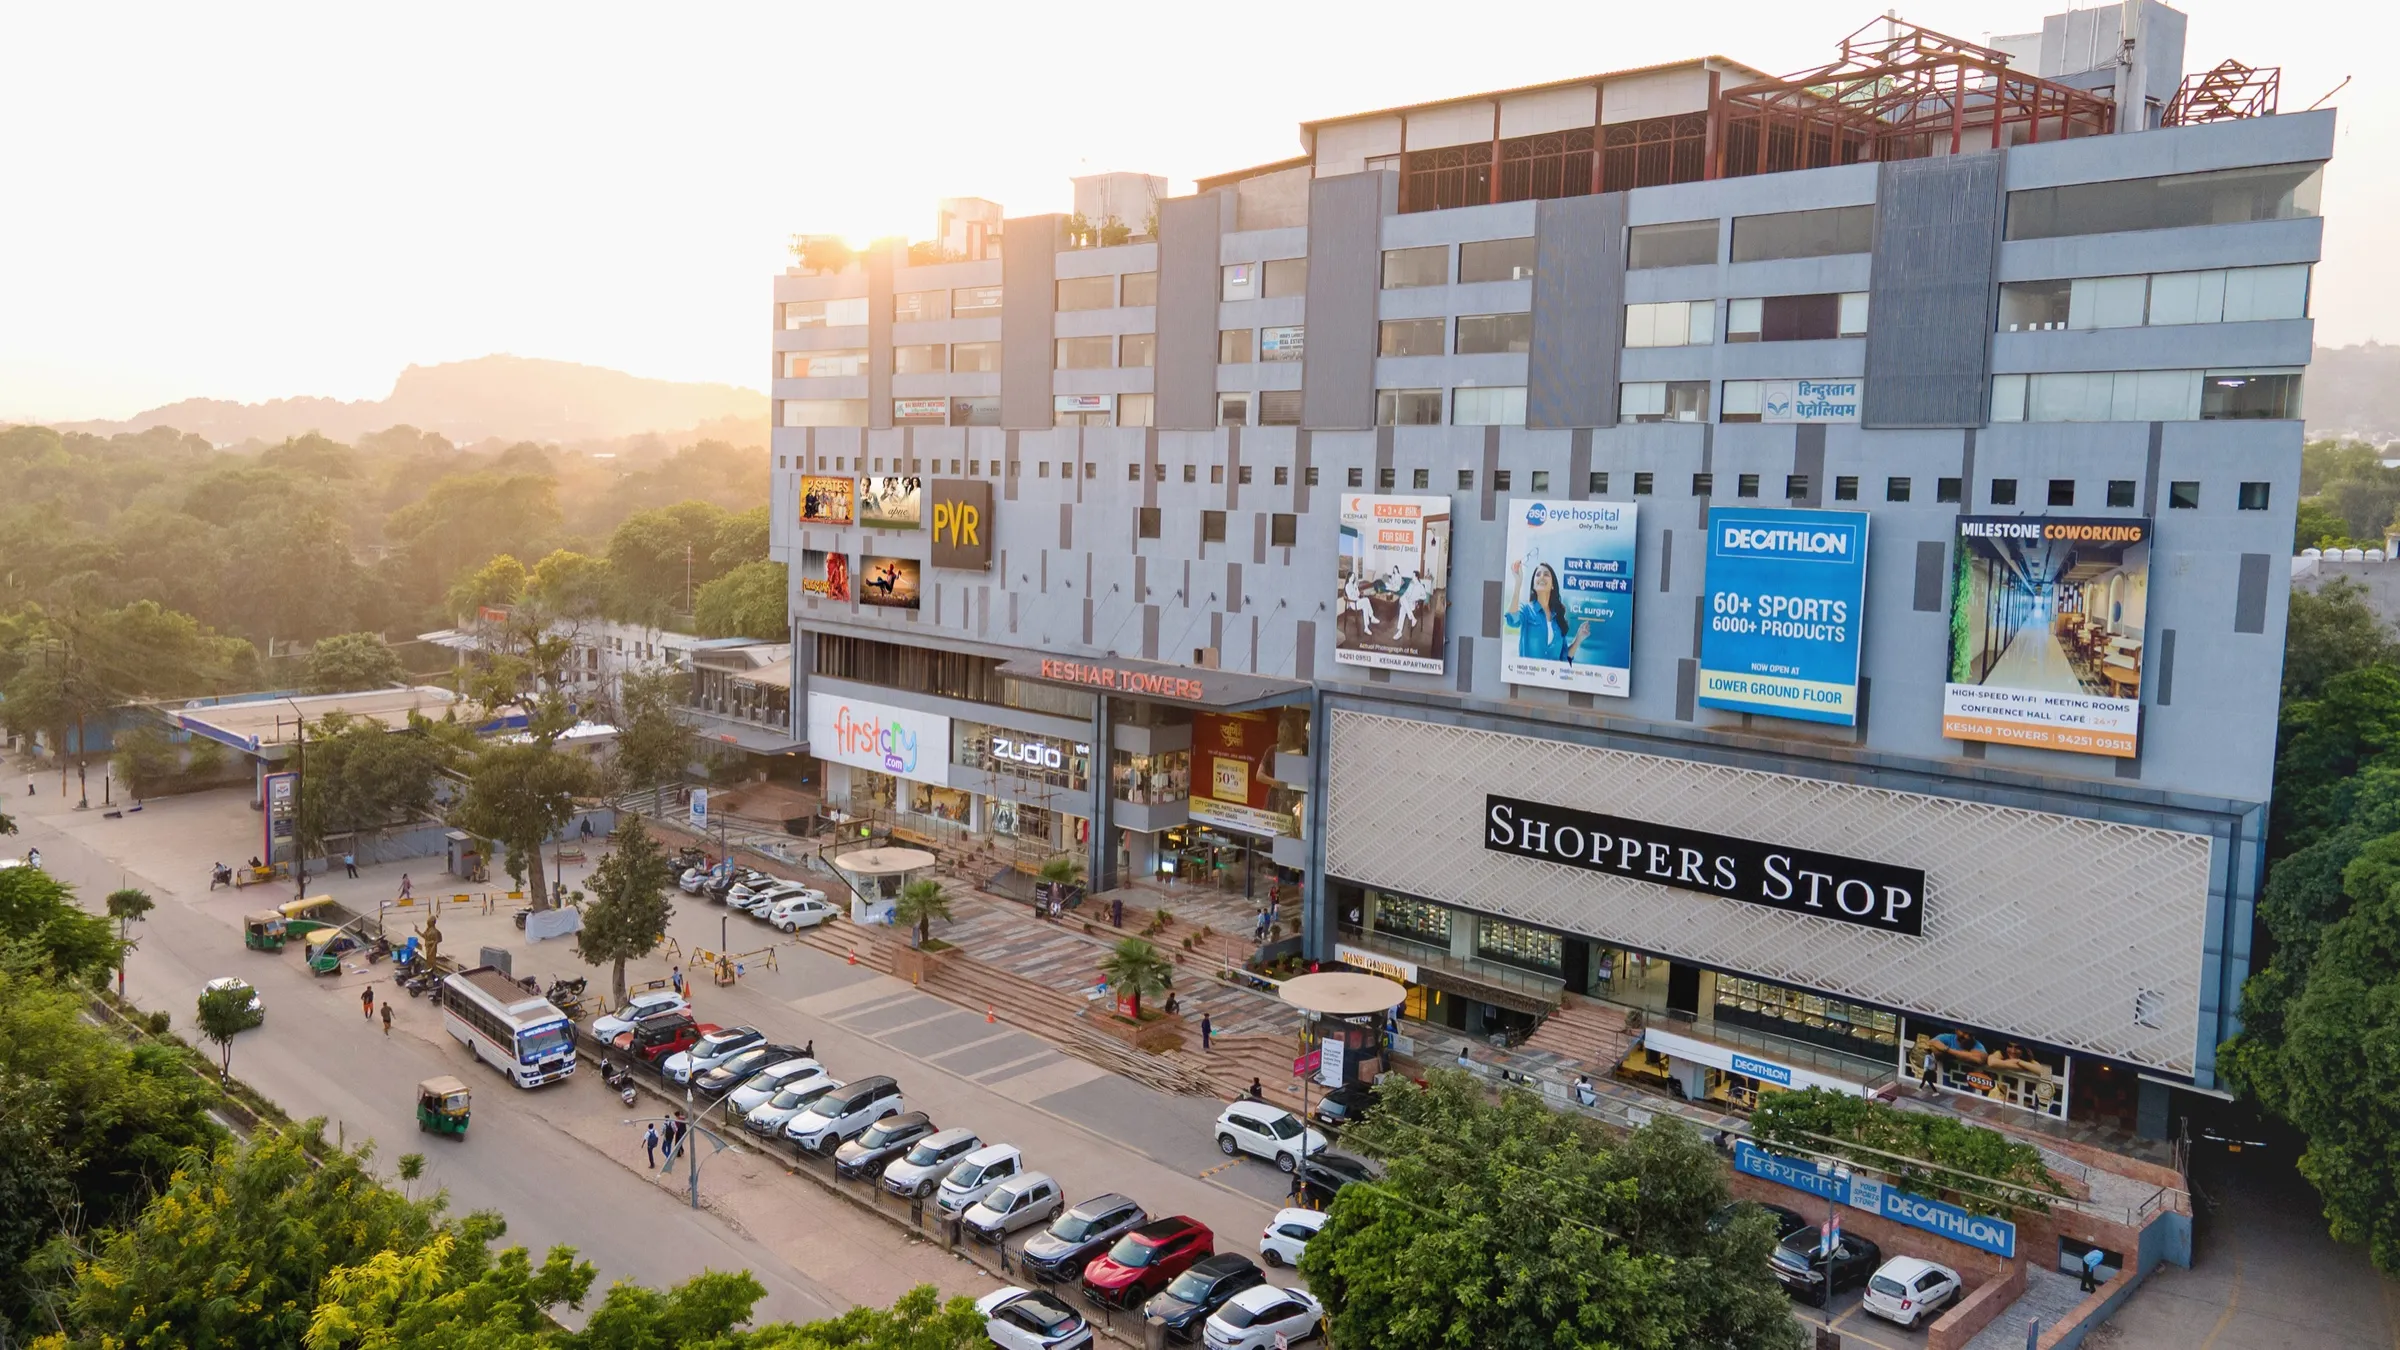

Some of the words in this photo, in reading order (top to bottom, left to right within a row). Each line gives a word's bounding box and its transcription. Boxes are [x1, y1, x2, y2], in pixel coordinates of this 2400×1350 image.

[1798, 380, 1856, 400] हिन्दुस्तान
[1796, 401, 1856, 419] पेट्रोलियम
[815, 479, 849, 493] STATES
[934, 498, 979, 550] PVR
[1528, 507, 1546, 522] asg
[1549, 508, 1570, 521] eye
[1572, 507, 1620, 523] hospital
[1382, 531, 1394, 542] FOR
[1394, 532, 1410, 543] SALE
[1579, 523, 1592, 531] Only
[1961, 522, 2041, 539] MILESTONE
[2044, 524, 2142, 542] COWORKING
[1373, 544, 1400, 552] FURNISHED
[1724, 528, 1846, 554] DECATHLON
[1584, 607, 1614, 618] surgery
[1713, 592, 1752, 614] 60+
[1758, 595, 1847, 624] SPORTS
[1712, 616, 1757, 634] 6000+
[1761, 620, 1846, 643] PRODUCTS
[1379, 657, 1402, 667] KESHAR
[1402, 660, 1442, 671] APARTMENTS
[1751, 662, 1768, 672] NOW
[1769, 664, 1790, 674] OPEN
[1790, 666, 1800, 676] AT
[1041, 659, 1116, 688] KESHAR
[1119, 670, 1203, 700] TOWERS
[1709, 677, 1748, 693] LOWER
[1750, 684, 1800, 700] GROUND
[1803, 688, 1842, 705] FLOOR
[1952, 688, 2009, 701] HIGH-SPEED
[2012, 693, 2037, 704] WI-FI
[2045, 697, 2089, 709] MEETING
[2091, 701, 2130, 713] ROOMS
[1961, 703, 2024, 718] CONFERENCE
[2026, 709, 2052, 720] HALL
[2059, 712, 2086, 724] CAFÉ
[833, 706, 918, 773] firstcry
[1946, 722, 1993, 737] KESHAR
[1995, 726, 2049, 742] TOWERS
[2058, 733, 2093, 747] 94251
[2096, 737, 2133, 751] 09513
[886, 757, 903, 770] .com
[1490, 804, 1737, 891] SHOPPERS
[1762, 853, 1912, 924] STOP
[1735, 1058, 1788, 1081] DECATHLON
[1966, 1075, 1993, 1087] FOSSIL
[1853, 1188, 1880, 1201] SPORTS
[1860, 1181, 1877, 1192] YOUR
[1854, 1197, 1876, 1208] STORE
[1888, 1195, 2005, 1247] DECATHLON
